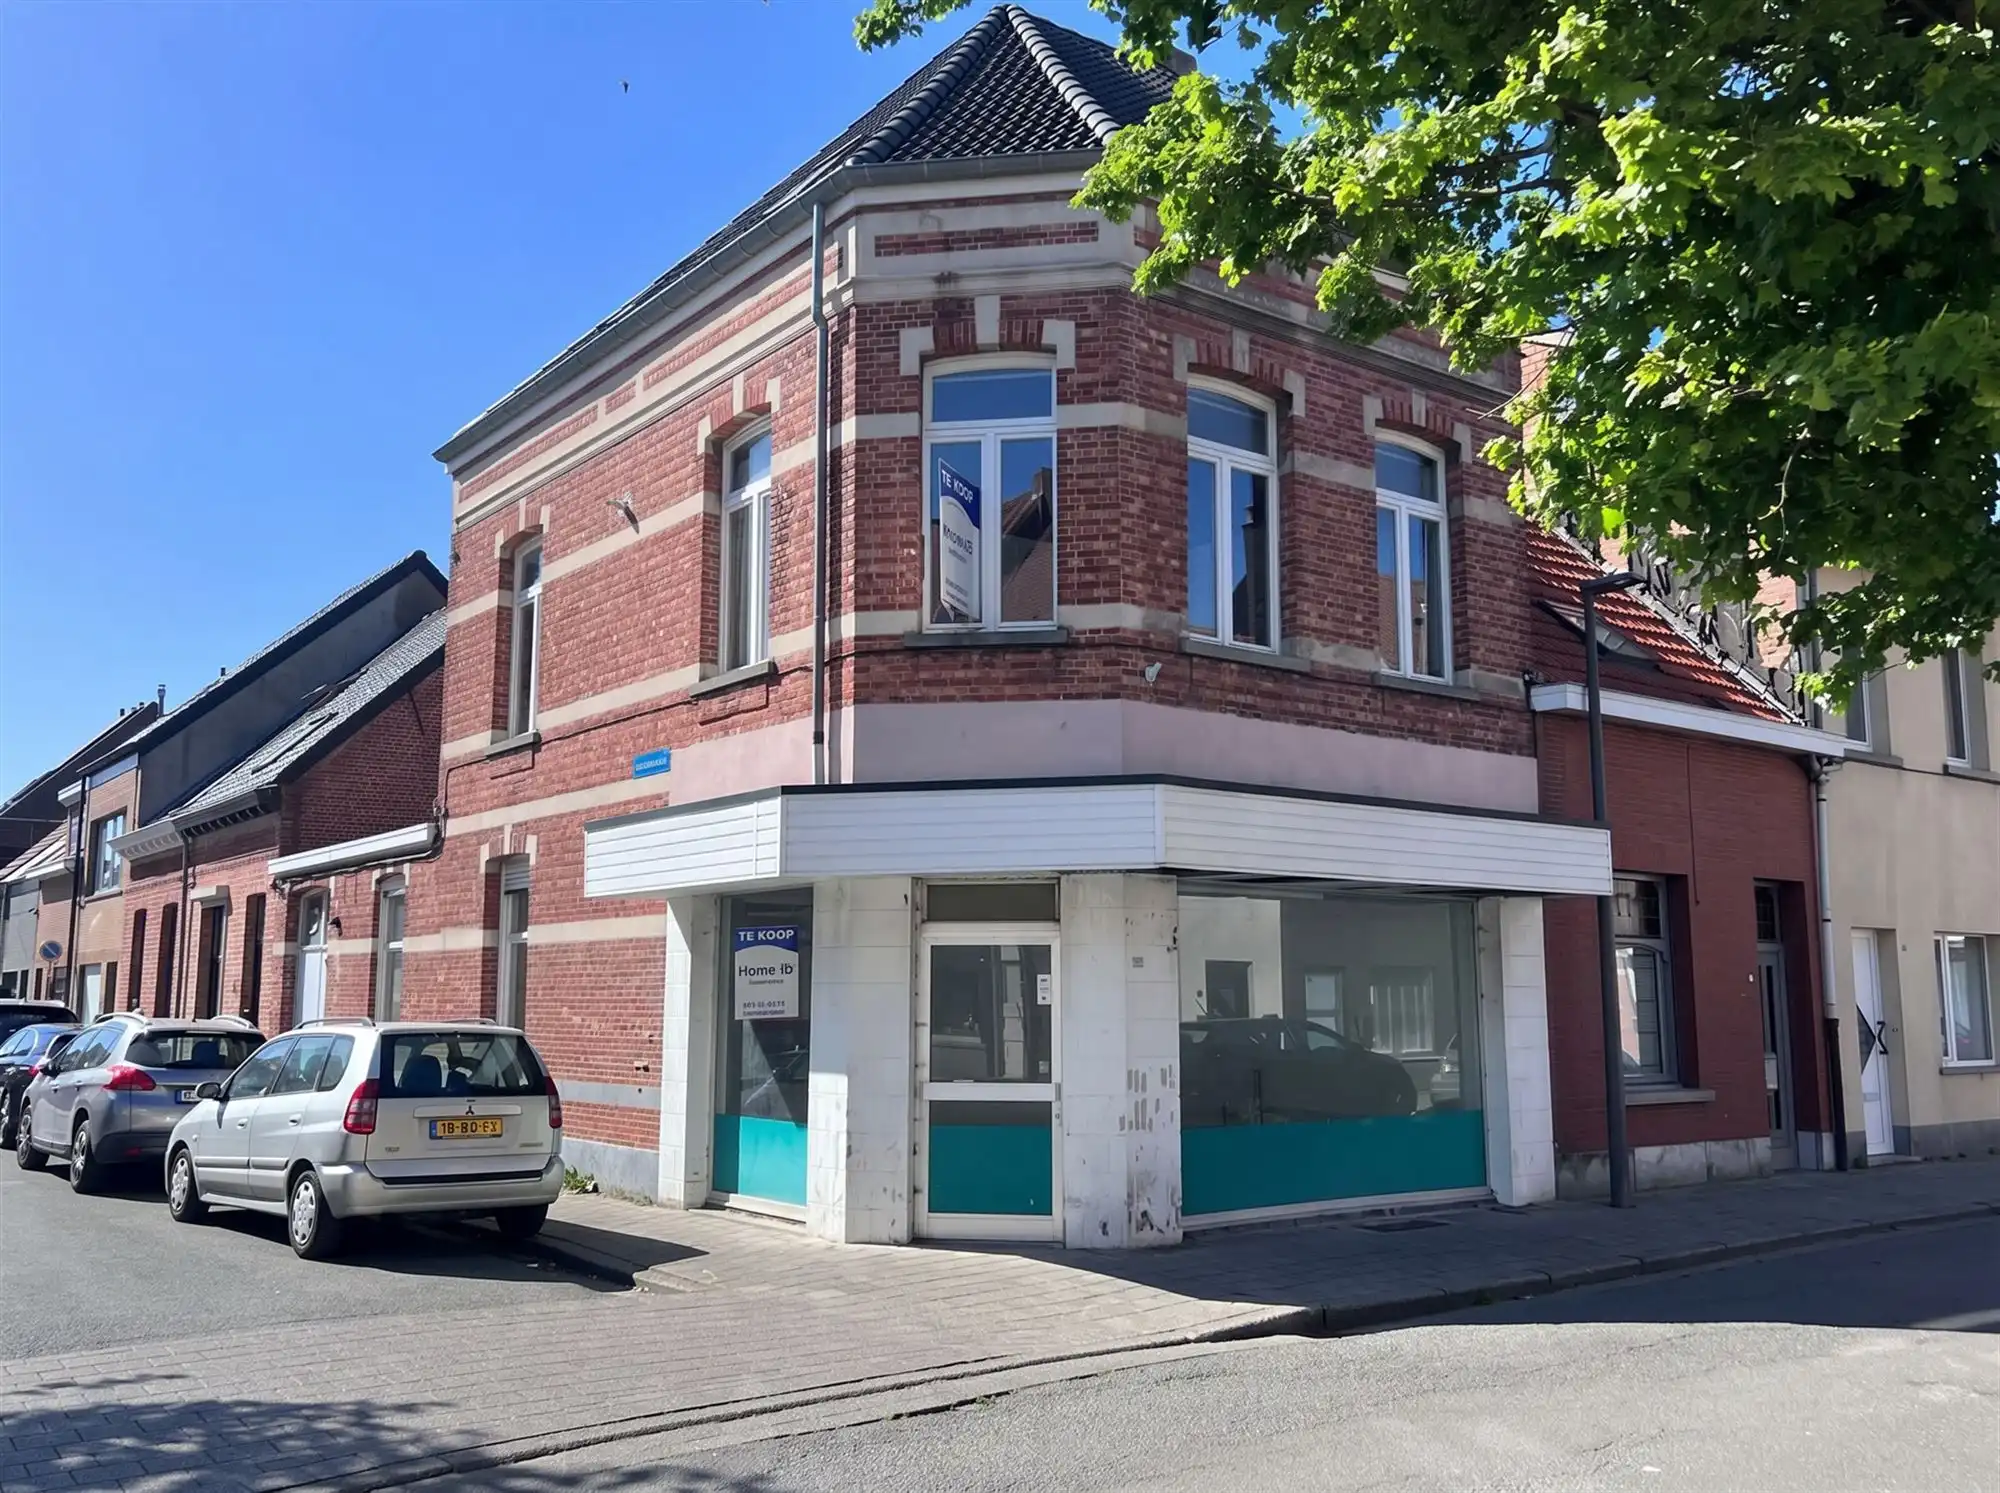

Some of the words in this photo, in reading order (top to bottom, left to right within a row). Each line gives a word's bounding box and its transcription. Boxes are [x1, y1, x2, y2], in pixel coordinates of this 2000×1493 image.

[941, 469, 952, 488] TE
[953, 478, 974, 504] KOOP
[738, 931, 755, 942] TE
[758, 929, 795, 941] KOOP
[738, 965, 776, 977] Home
